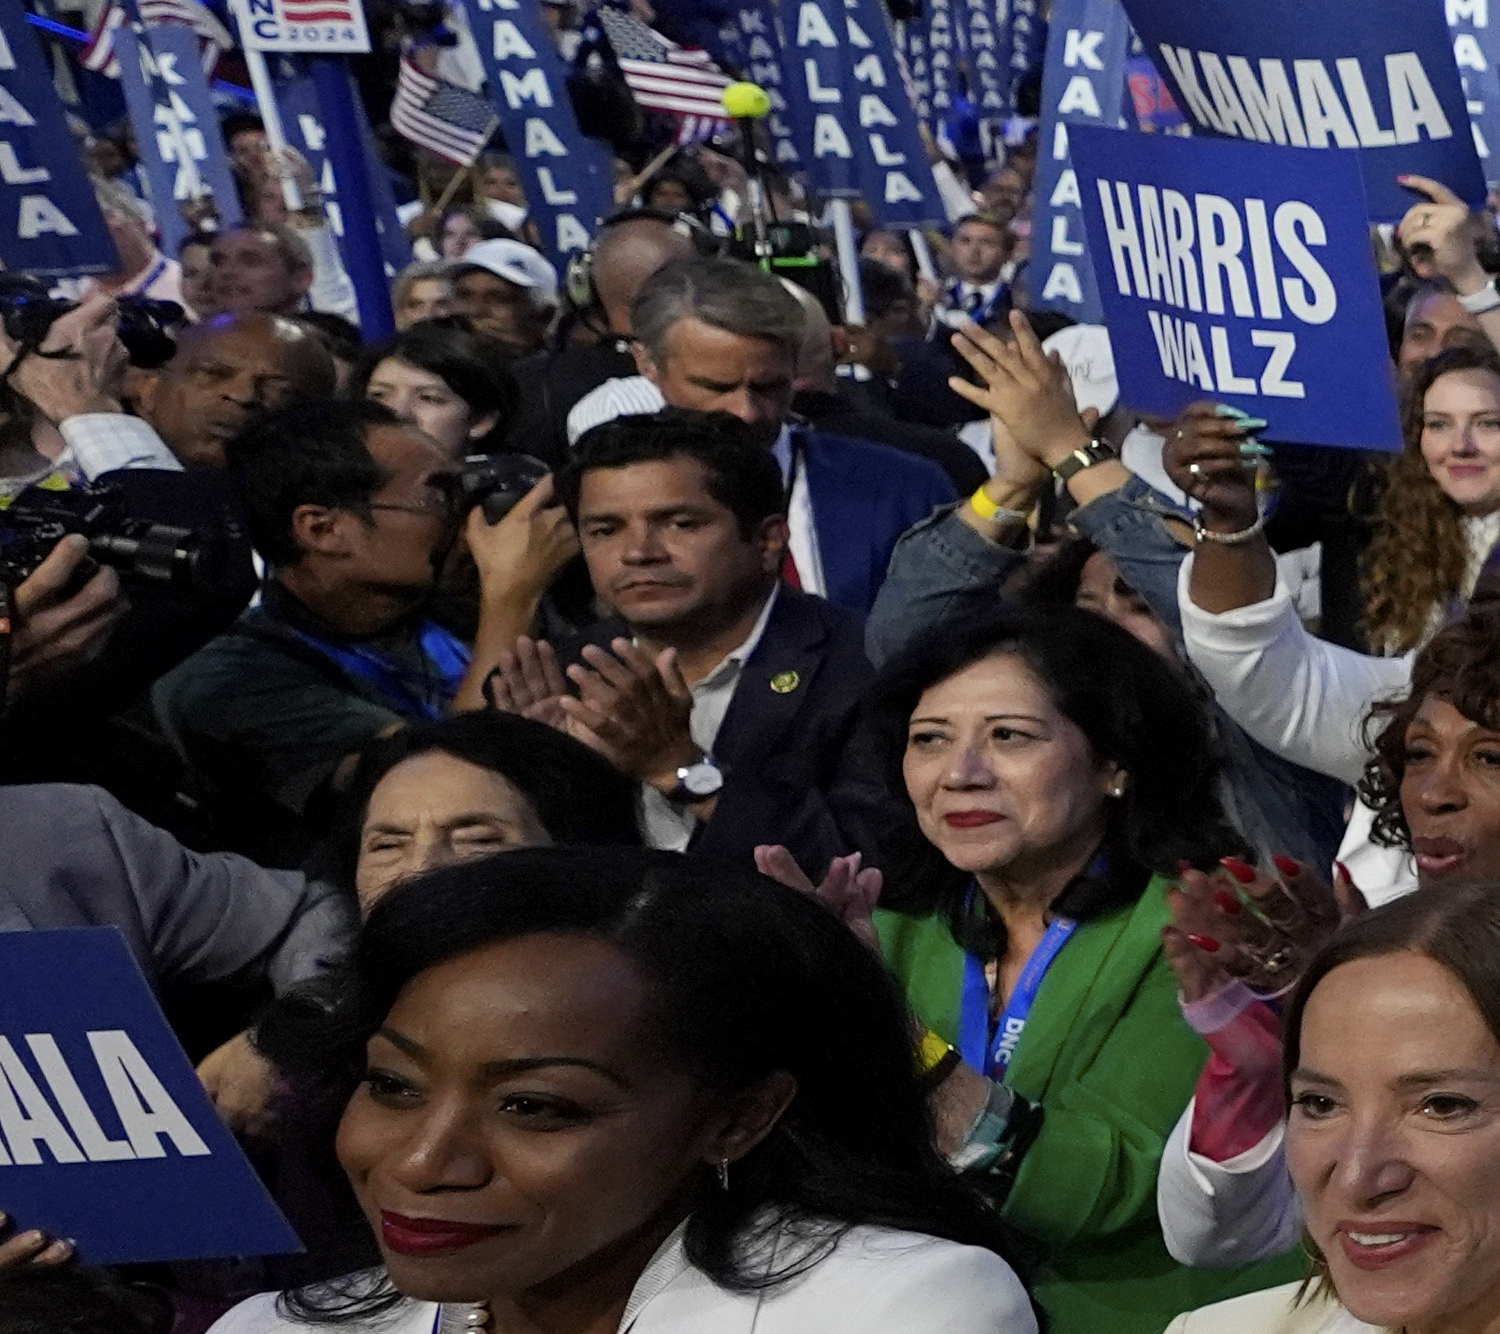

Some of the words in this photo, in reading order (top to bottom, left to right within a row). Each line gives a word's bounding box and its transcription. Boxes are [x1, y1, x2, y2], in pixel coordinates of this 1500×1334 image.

[1161, 42, 1452, 149] KAMALA
[1097, 176, 1337, 325] HARRIS
[1149, 309, 1305, 399] WALZ
[995, 1017, 1025, 1064] DNC
[0, 1029, 211, 1165] ALA
